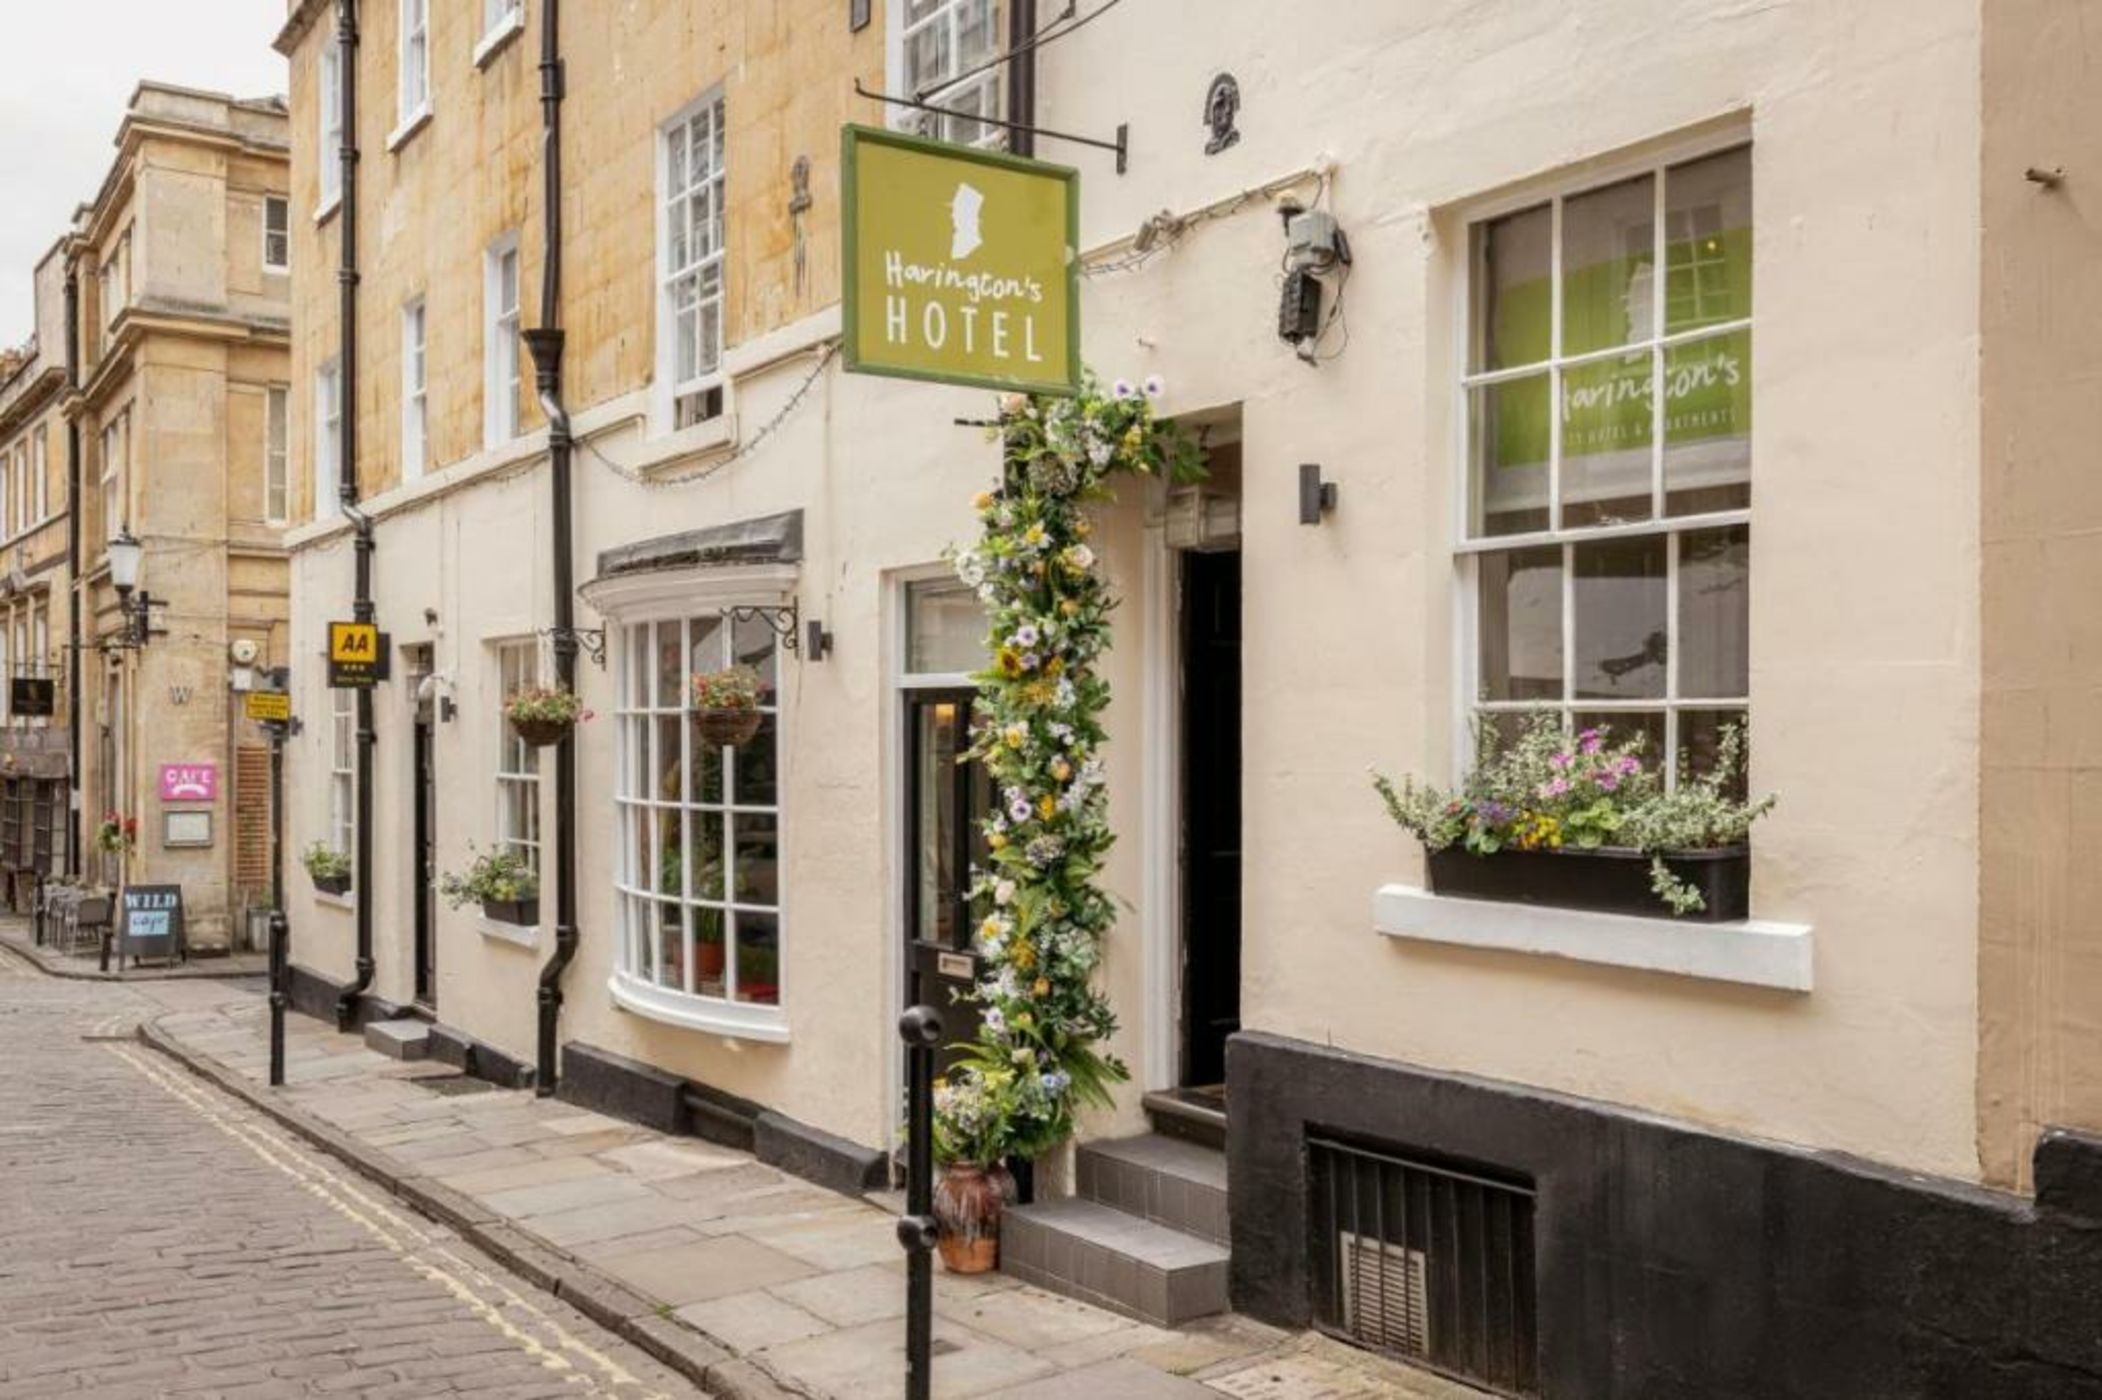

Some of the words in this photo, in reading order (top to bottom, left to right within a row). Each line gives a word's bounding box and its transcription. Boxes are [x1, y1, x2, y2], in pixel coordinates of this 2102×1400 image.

[885, 250, 1043, 303] Harington's
[886, 295, 1043, 363] HOTEL
[341, 633, 369, 652] AA
[125, 893, 178, 909] WILD
